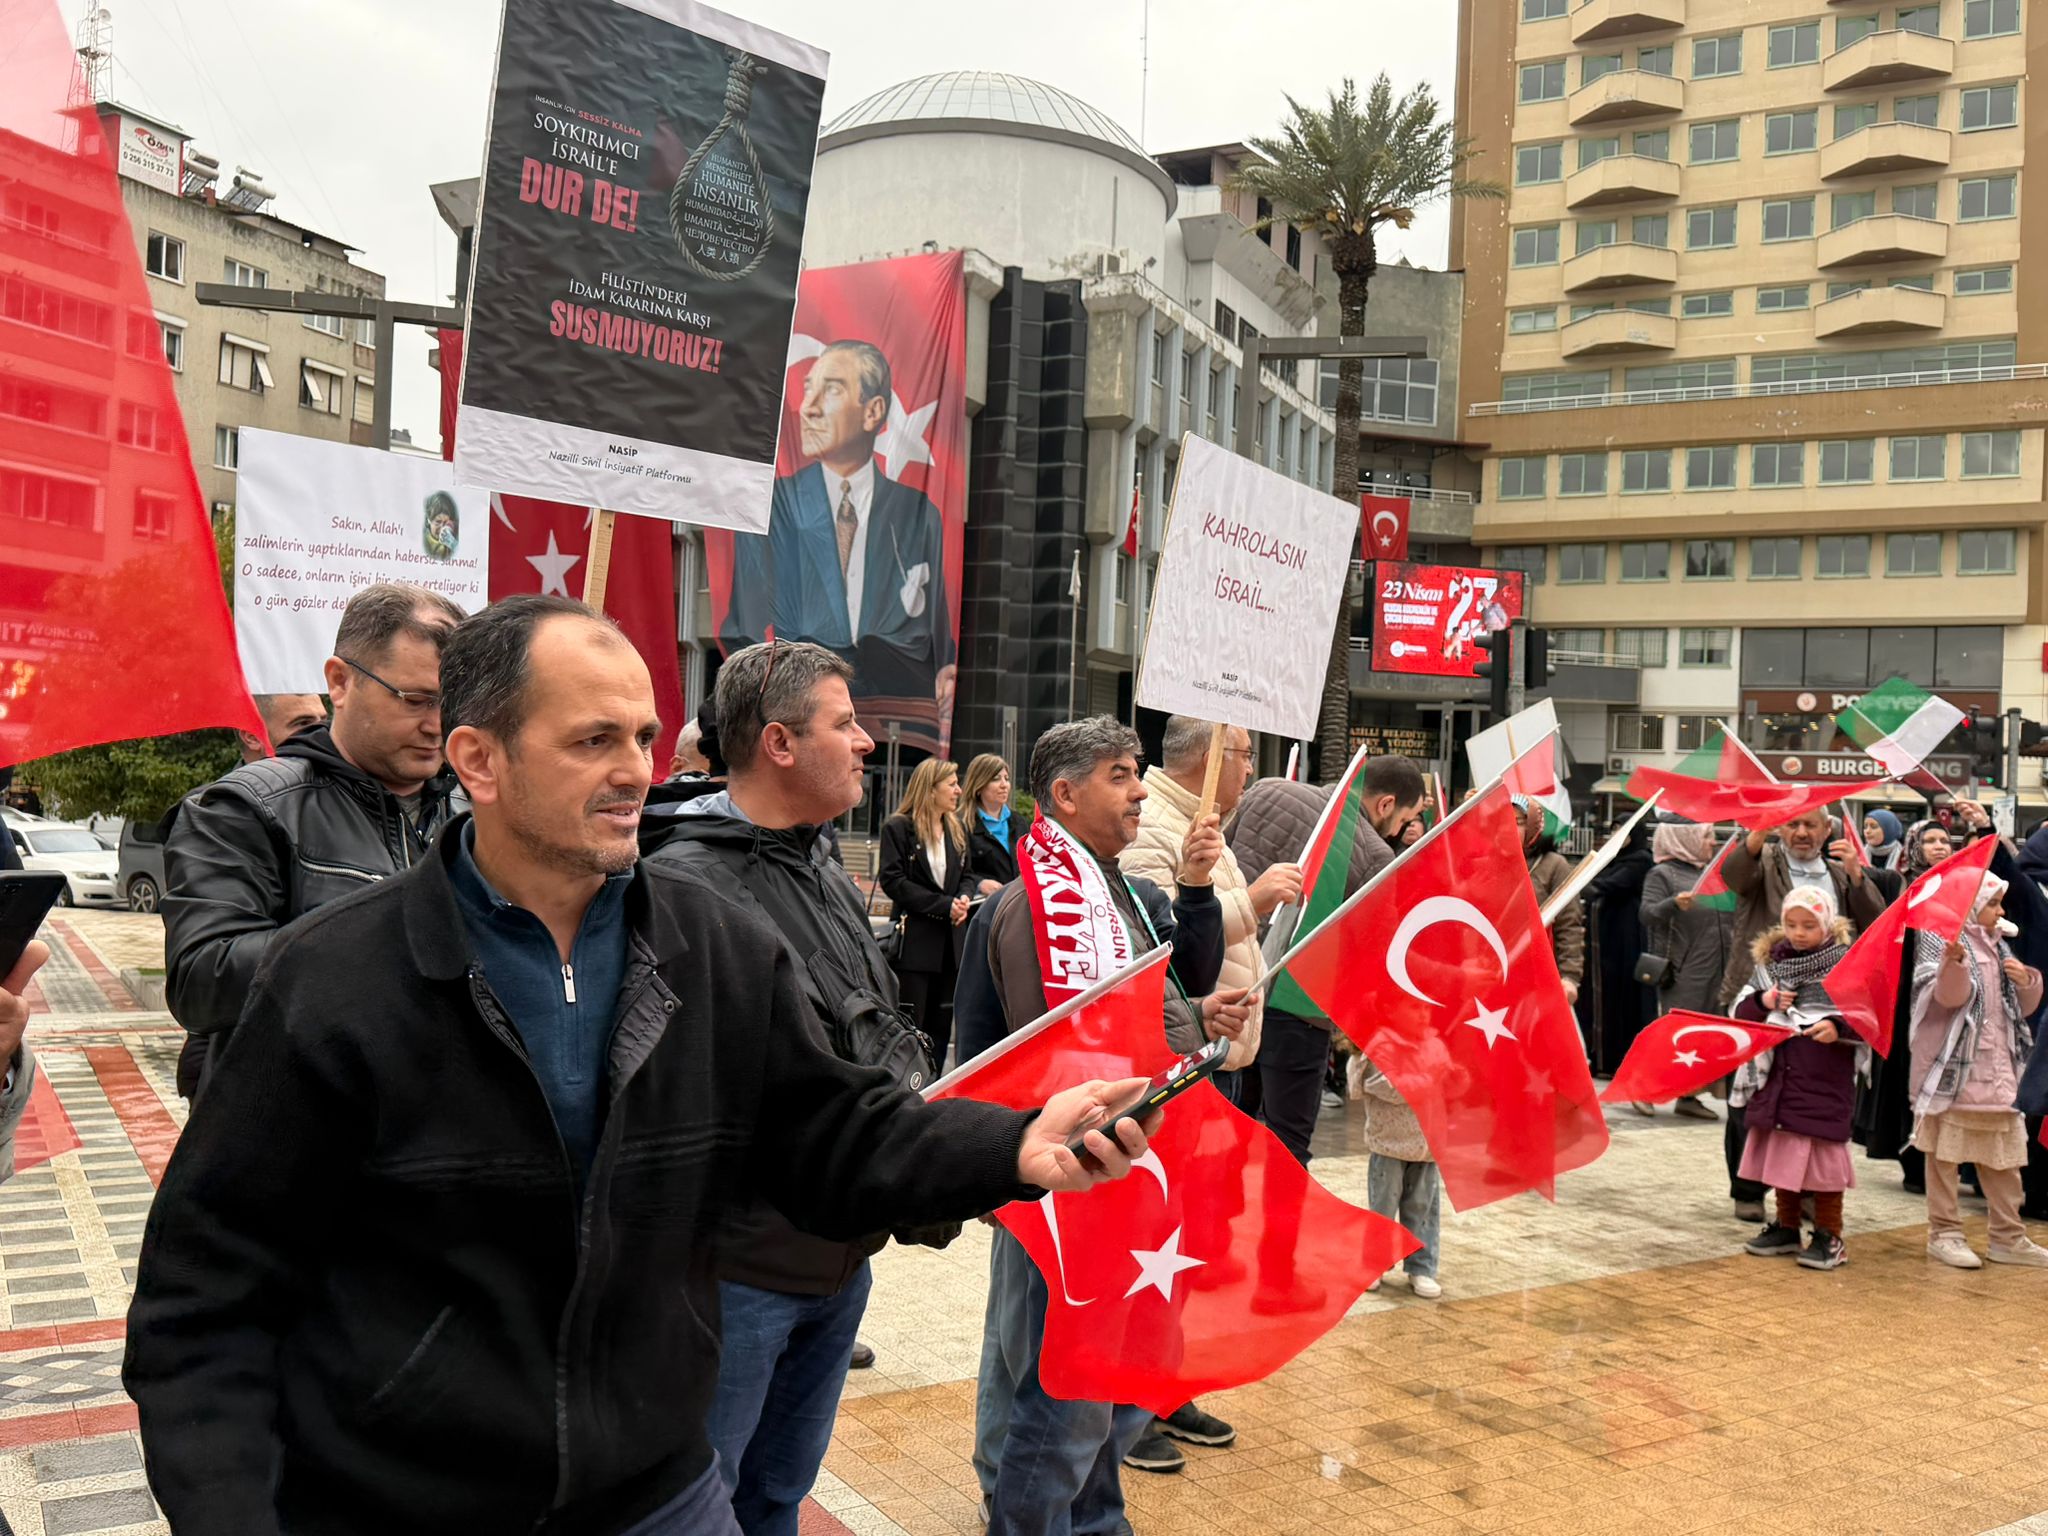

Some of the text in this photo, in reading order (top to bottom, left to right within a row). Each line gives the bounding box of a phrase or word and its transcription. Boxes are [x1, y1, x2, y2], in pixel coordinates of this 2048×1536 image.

[534, 112, 640, 160] SOYKIRIMCI
[578, 110, 609, 126] SESSİZ
[612, 121, 642, 137] KALMA
[552, 138, 618, 176] İSRAİL'E
[711, 153, 749, 172] HUMANITY
[519, 156, 640, 233] DUR DE!
[692, 178, 760, 216] İNSANLIK
[701, 170, 756, 197] HUMANITÉ
[685, 198, 732, 219] HUMANIDAD
[569, 278, 711, 329] İDAM KARARINA KARŞI
[601, 272, 687, 306] FİLİSTİN'DEKİ
[550, 299, 723, 374] SUSMUYORUZ!
[608, 444, 638, 457] NASİP
[548, 450, 692, 484] Nazilli Sivil İnsiyatif Platformu
[331, 515, 366, 533] Sakın,
[244, 534, 304, 552] zalimlerin
[308, 541, 391, 562] yaptıklarından
[1202, 511, 1308, 570] KAHROLASIN
[242, 563, 252, 576] O
[256, 565, 302, 582] sadece,
[305, 569, 345, 584] onların
[349, 570, 371, 588] işini
[423, 578, 467, 596] erteliyor
[469, 580, 480, 593] ki
[1381, 580, 1444, 602] 23 Nisan
[254, 596, 262, 606] o
[265, 593, 289, 611] gün
[293, 594, 328, 612] gözler
[1817, 758, 1889, 776] BURGE
